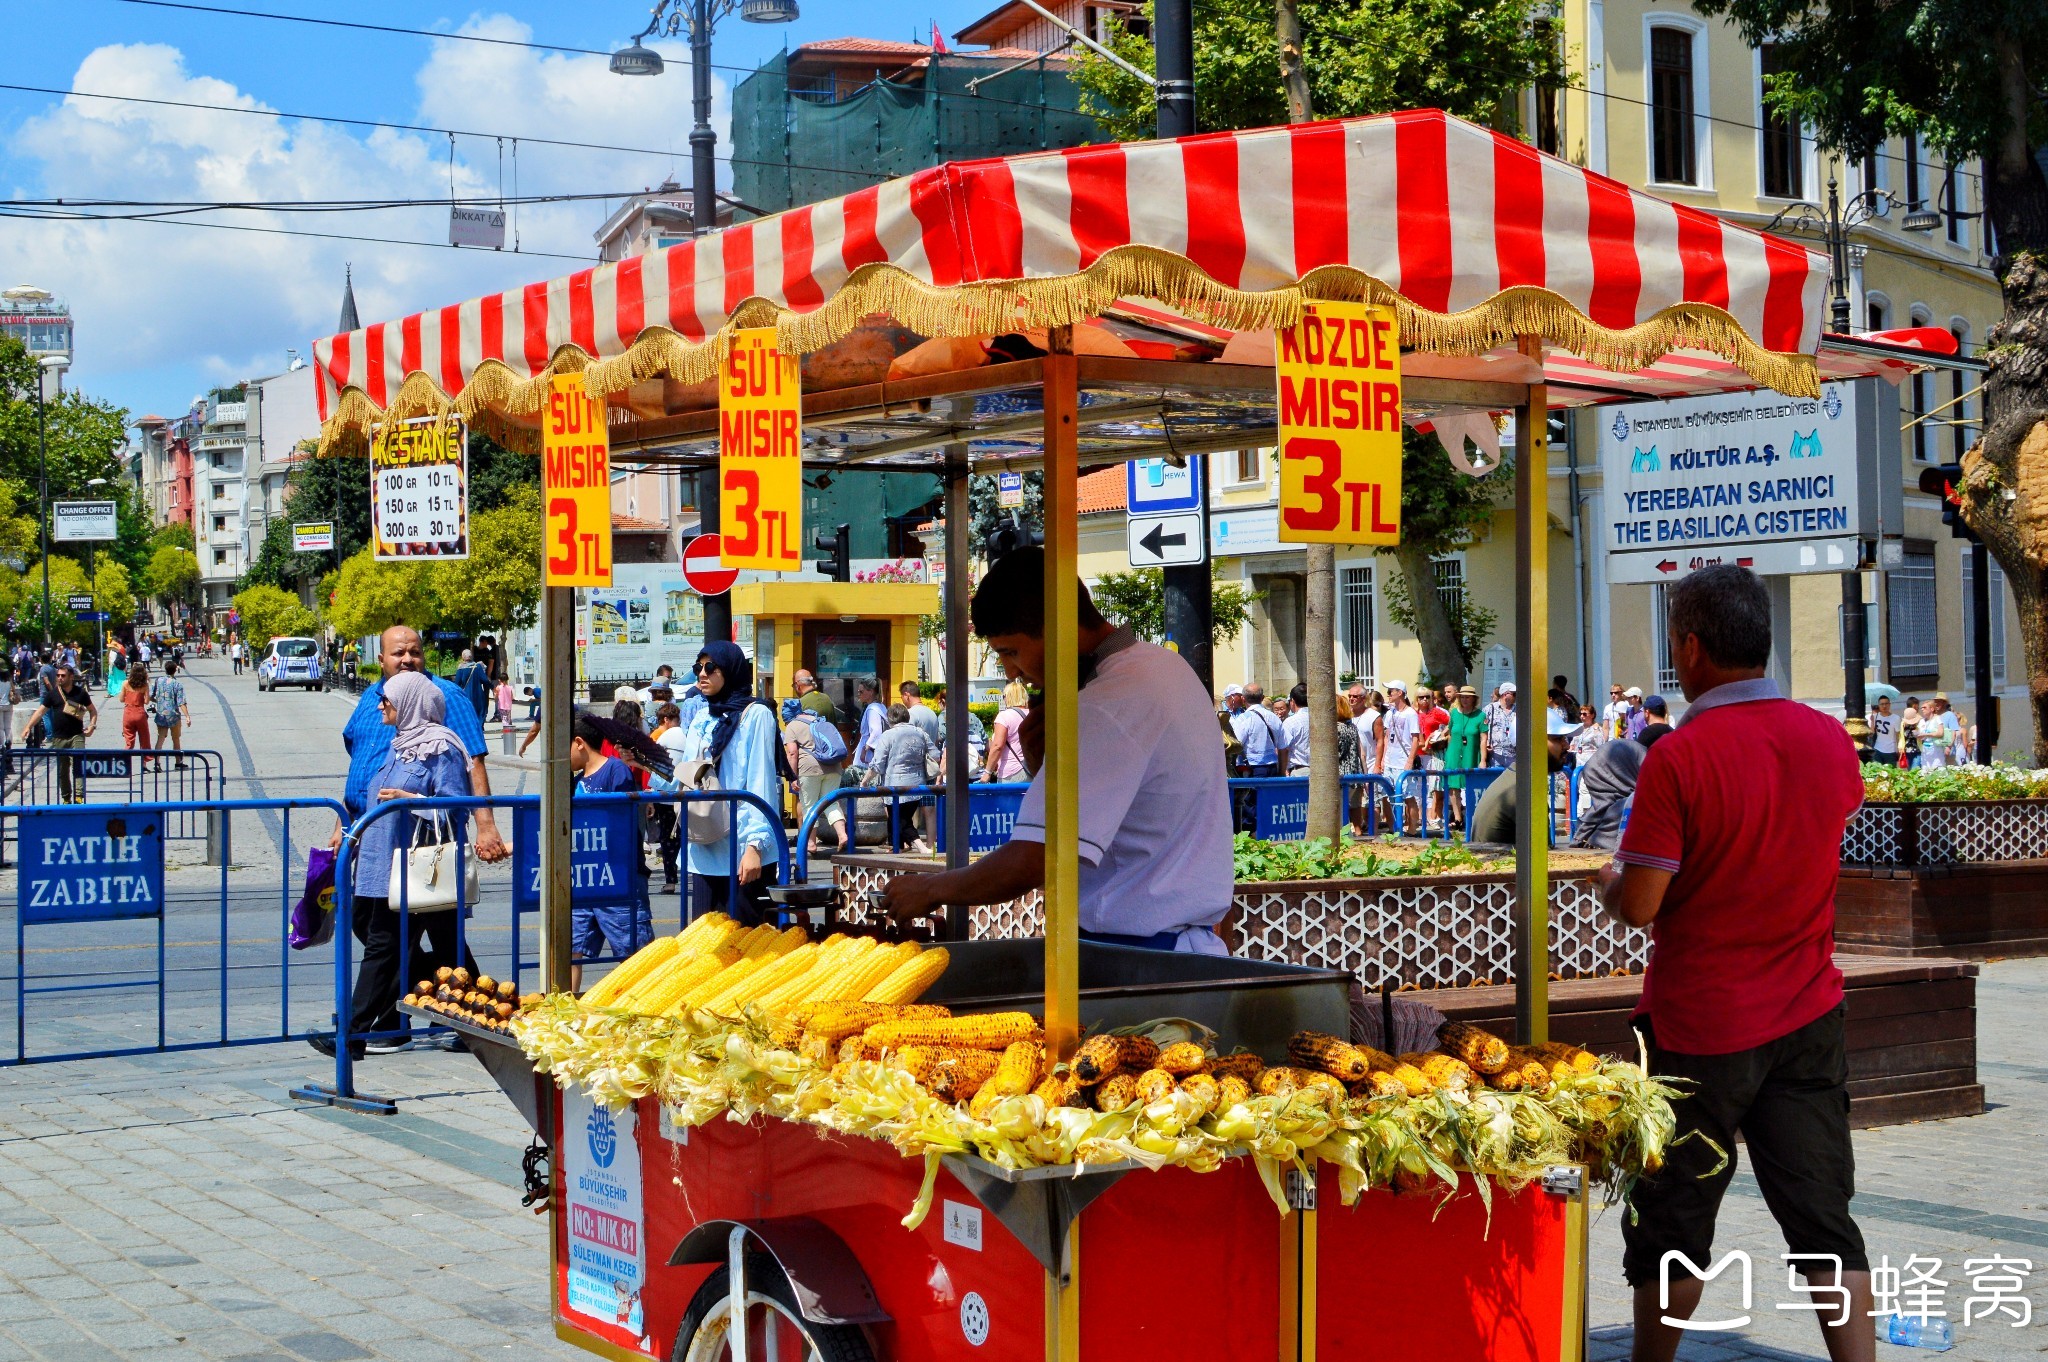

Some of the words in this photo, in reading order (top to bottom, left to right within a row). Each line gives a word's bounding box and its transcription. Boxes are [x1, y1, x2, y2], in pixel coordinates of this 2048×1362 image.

[1281, 305, 1393, 370] KÖZDE
[730, 339, 781, 397] SÜT
[1280, 375, 1400, 432] MISIR
[1633, 416, 1684, 434] İSTANBUL
[1756, 400, 1819, 420] BELEDİYESİ
[377, 426, 458, 466] KESTANE
[722, 409, 798, 457] MISIR
[547, 444, 607, 488] MISIR
[1670, 444, 1741, 471] KÜLTÜR
[1744, 444, 1780, 466] A.Ş.
[385, 475, 403, 490] 100
[406, 477, 417, 489] GR
[427, 471, 440, 487] 10
[443, 475, 453, 486] TL
[1624, 483, 1742, 513] YEREBATAN
[1748, 475, 1834, 503] SARNICI
[60, 506, 88, 515] CHANGE
[88, 506, 111, 514] OFFICE
[385, 499, 404, 514] 150
[406, 502, 418, 513] GR
[428, 496, 441, 512] 15
[444, 499, 454, 511] TL
[385, 522, 404, 538] 300
[407, 525, 418, 537] GR
[430, 520, 443, 536] 30
[447, 524, 456, 536] TL
[1614, 521, 1651, 544] THE
[1657, 513, 1750, 542] BASILICA
[1754, 506, 1847, 535] CISTERN
[1689, 556, 1704, 570] 40
[81, 758, 126, 775] POLİS
[969, 807, 1015, 836] ATİH
[30, 875, 153, 907] ZABITA
[531, 862, 615, 891] ZITA
[579, 1174, 628, 1202] BÜYÜKŞEHİR
[574, 1207, 595, 1238] NO:
[621, 1222, 634, 1252] 81
[573, 1242, 612, 1270] SÜLEYMAN
[613, 1258, 637, 1280] KEZER
